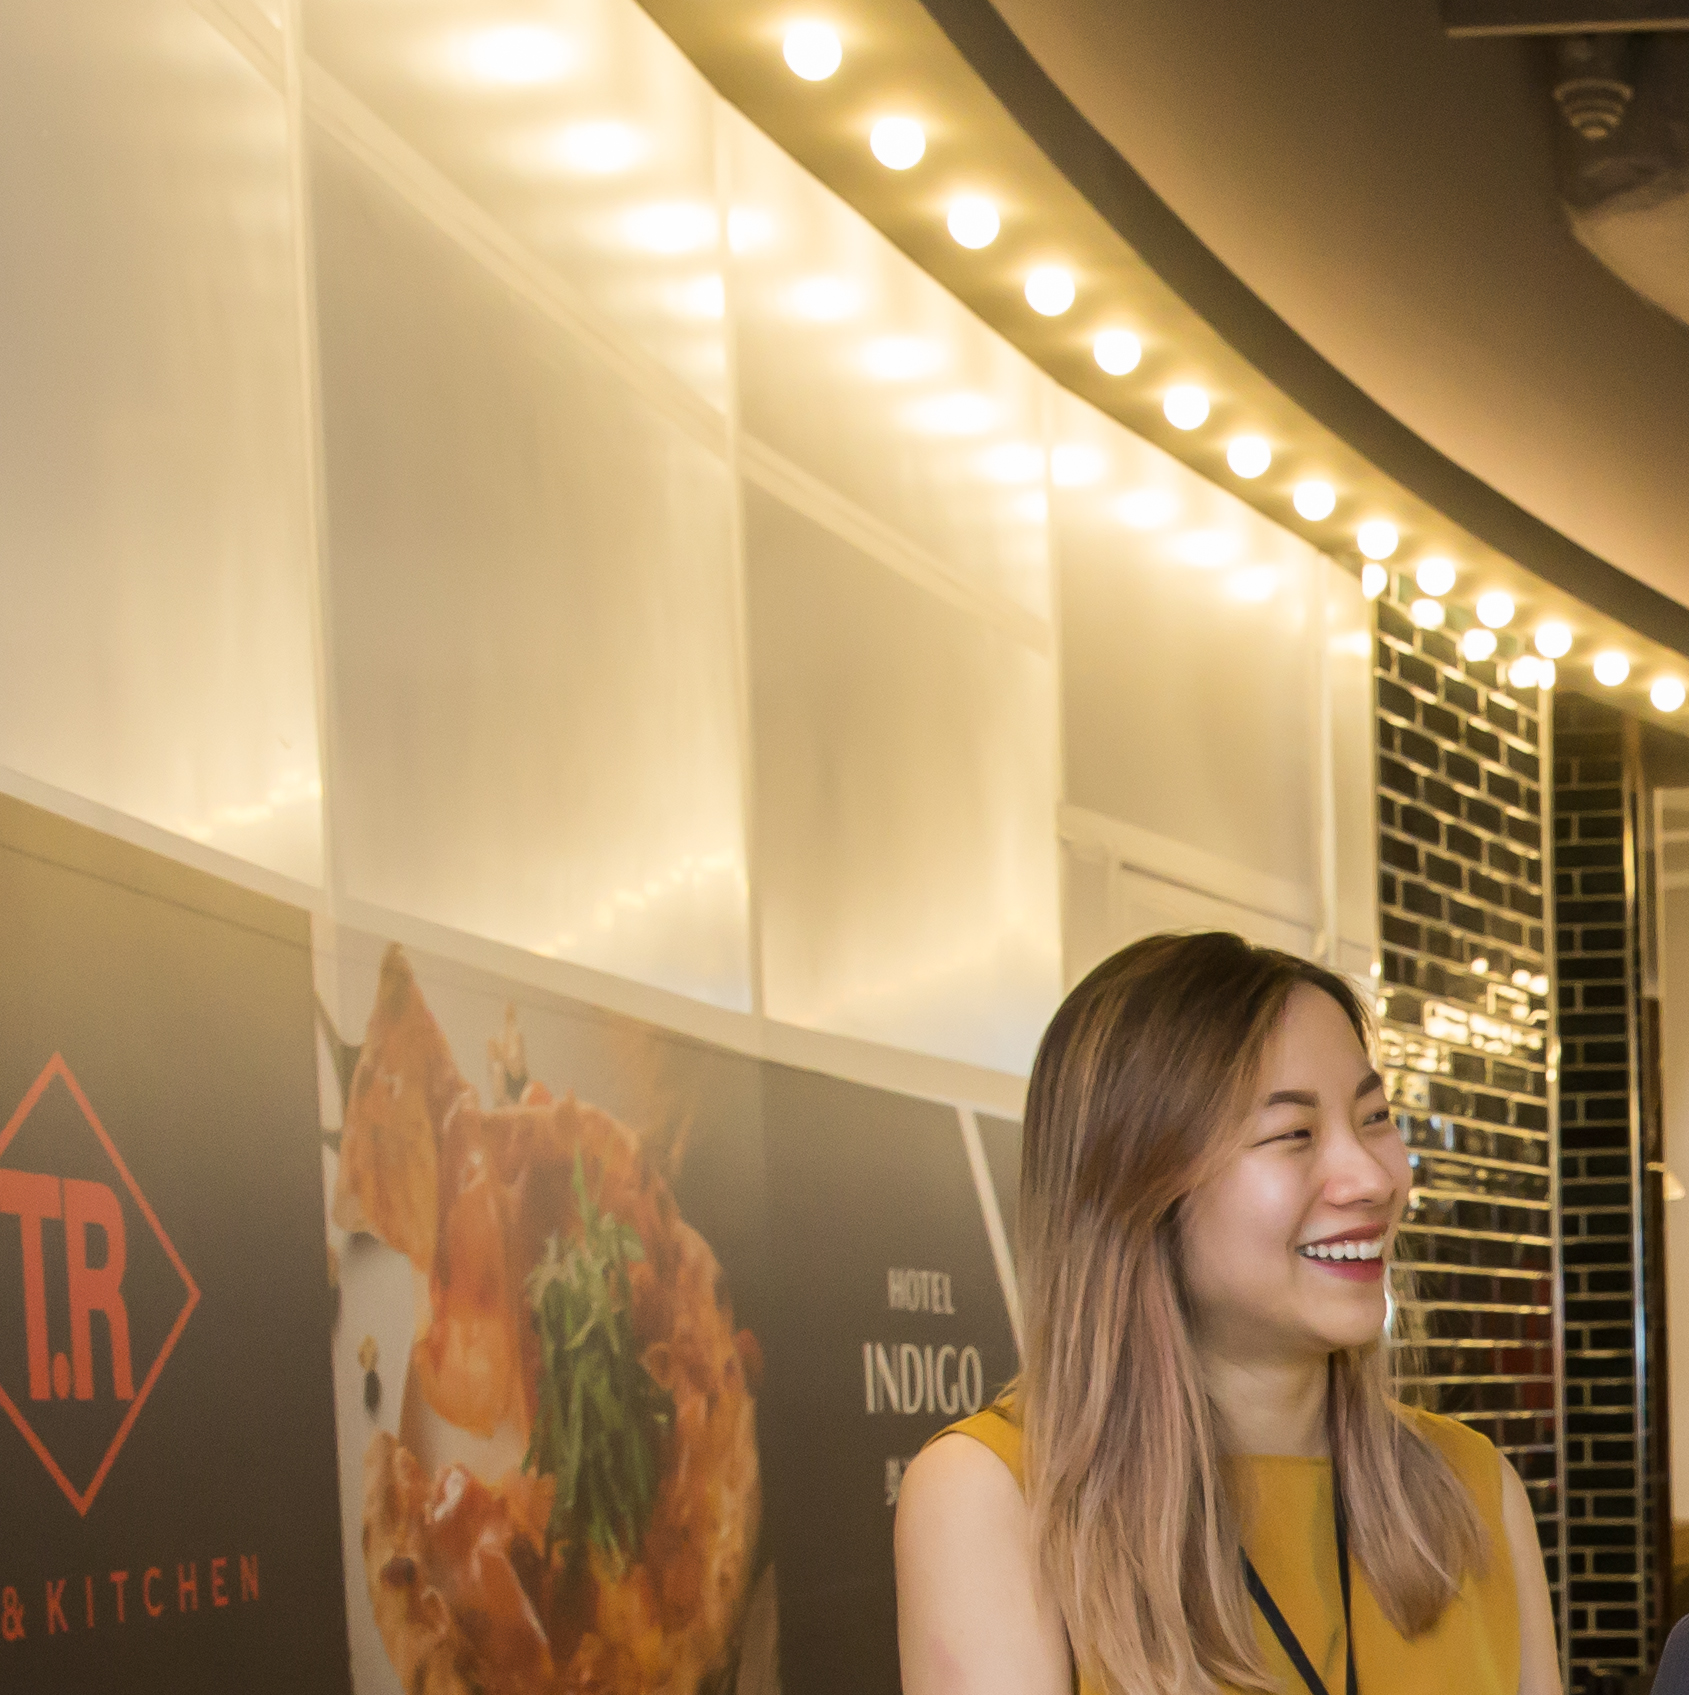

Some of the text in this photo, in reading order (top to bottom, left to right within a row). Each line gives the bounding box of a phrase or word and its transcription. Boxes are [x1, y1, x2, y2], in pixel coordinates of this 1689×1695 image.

[886, 1267, 956, 1315] HOTEL
[863, 1341, 983, 1416] INDIGO
[45, 1554, 260, 1635] KITCHEN
